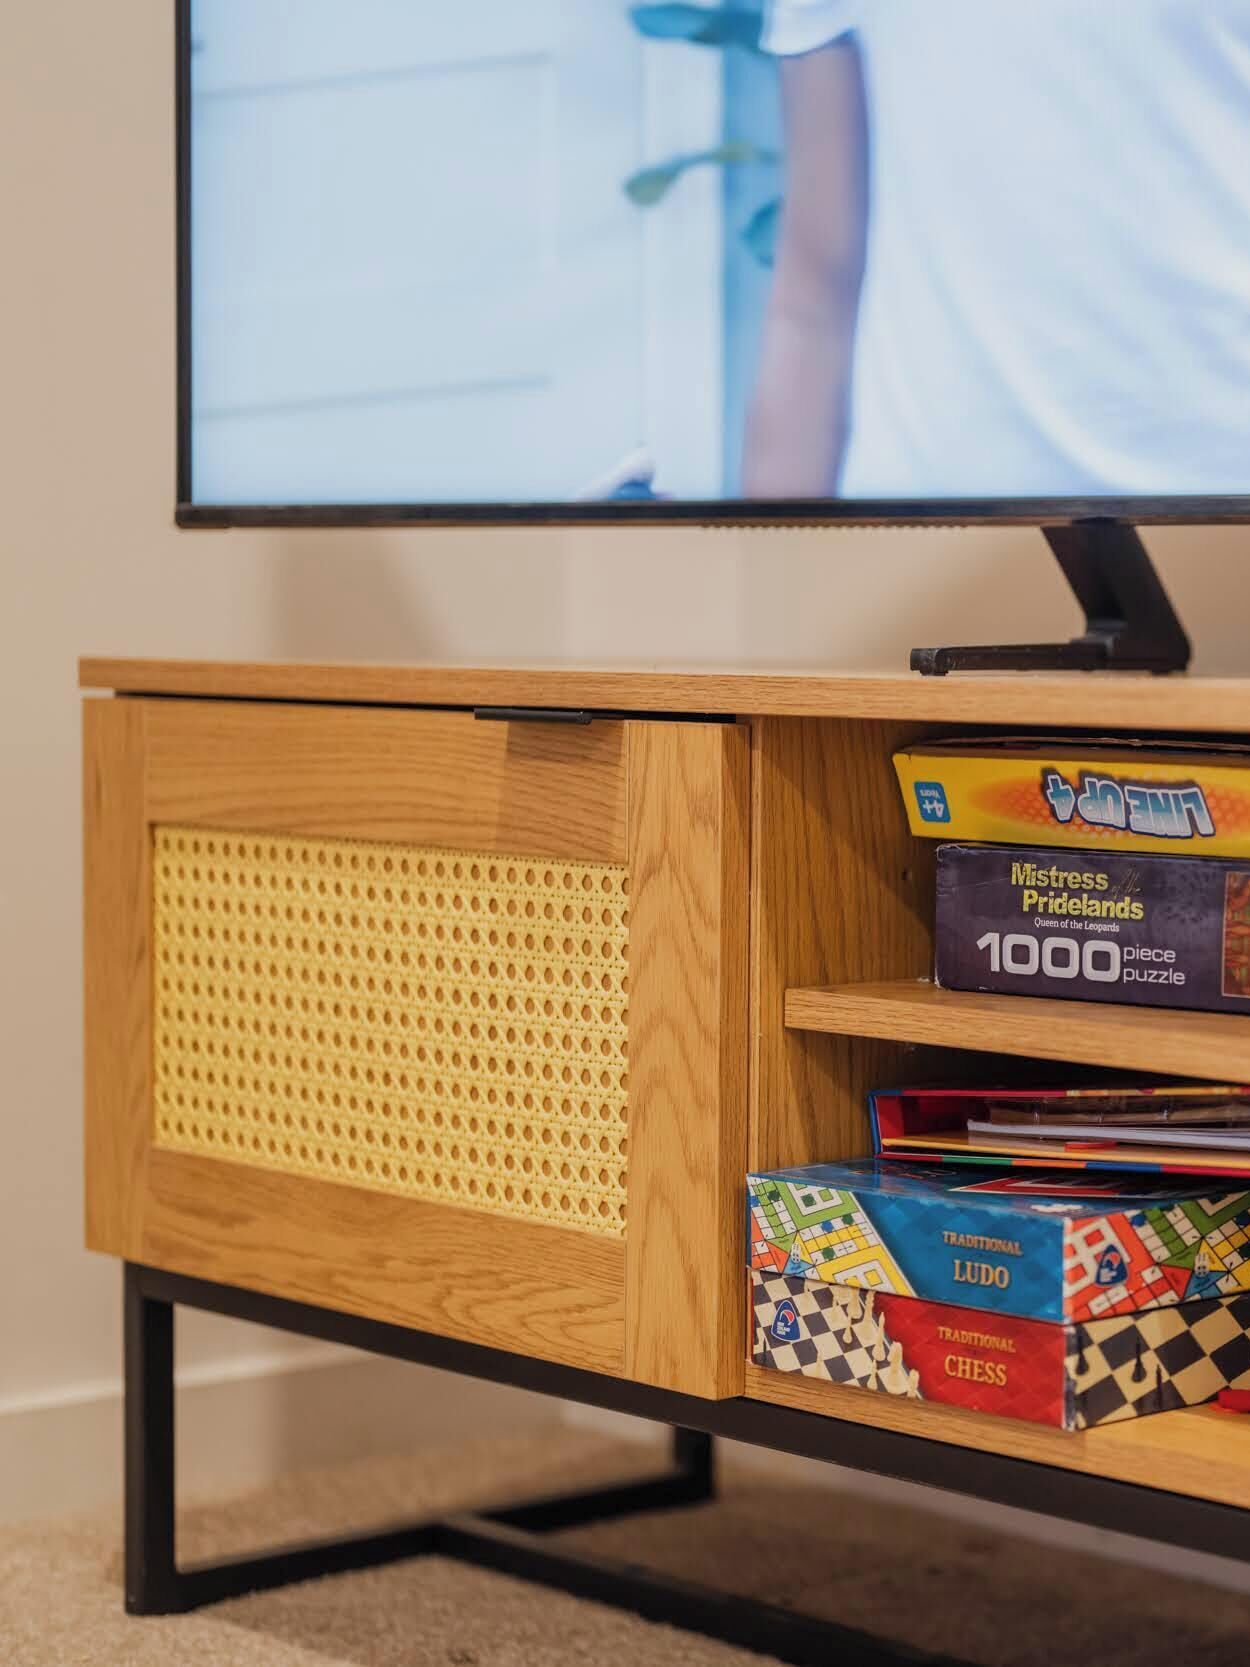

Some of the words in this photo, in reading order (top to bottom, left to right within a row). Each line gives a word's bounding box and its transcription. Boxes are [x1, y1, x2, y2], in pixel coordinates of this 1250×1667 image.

[922, 799, 944, 818] 4+
[1045, 773, 1077, 823] 4
[1077, 776, 1127, 830] UP
[1124, 783, 1217, 839] LINE
[1011, 862, 1109, 891] Mistress
[1022, 889, 1145, 920] Pridelands
[1034, 917, 1059, 928] Queen
[1060, 919, 1070, 929] of
[1070, 919, 1083, 930] the
[1084, 920, 1120, 933] Leopards
[976, 932, 1122, 983] 1000
[1123, 944, 1177, 964] piece
[1123, 966, 1186, 985] puzzle
[943, 1230, 1023, 1256] TRADITIONAL
[953, 1259, 1009, 1289] LUDO
[937, 1326, 1017, 1353] TRADITIONAL
[945, 1354, 1007, 1387] CHESS
